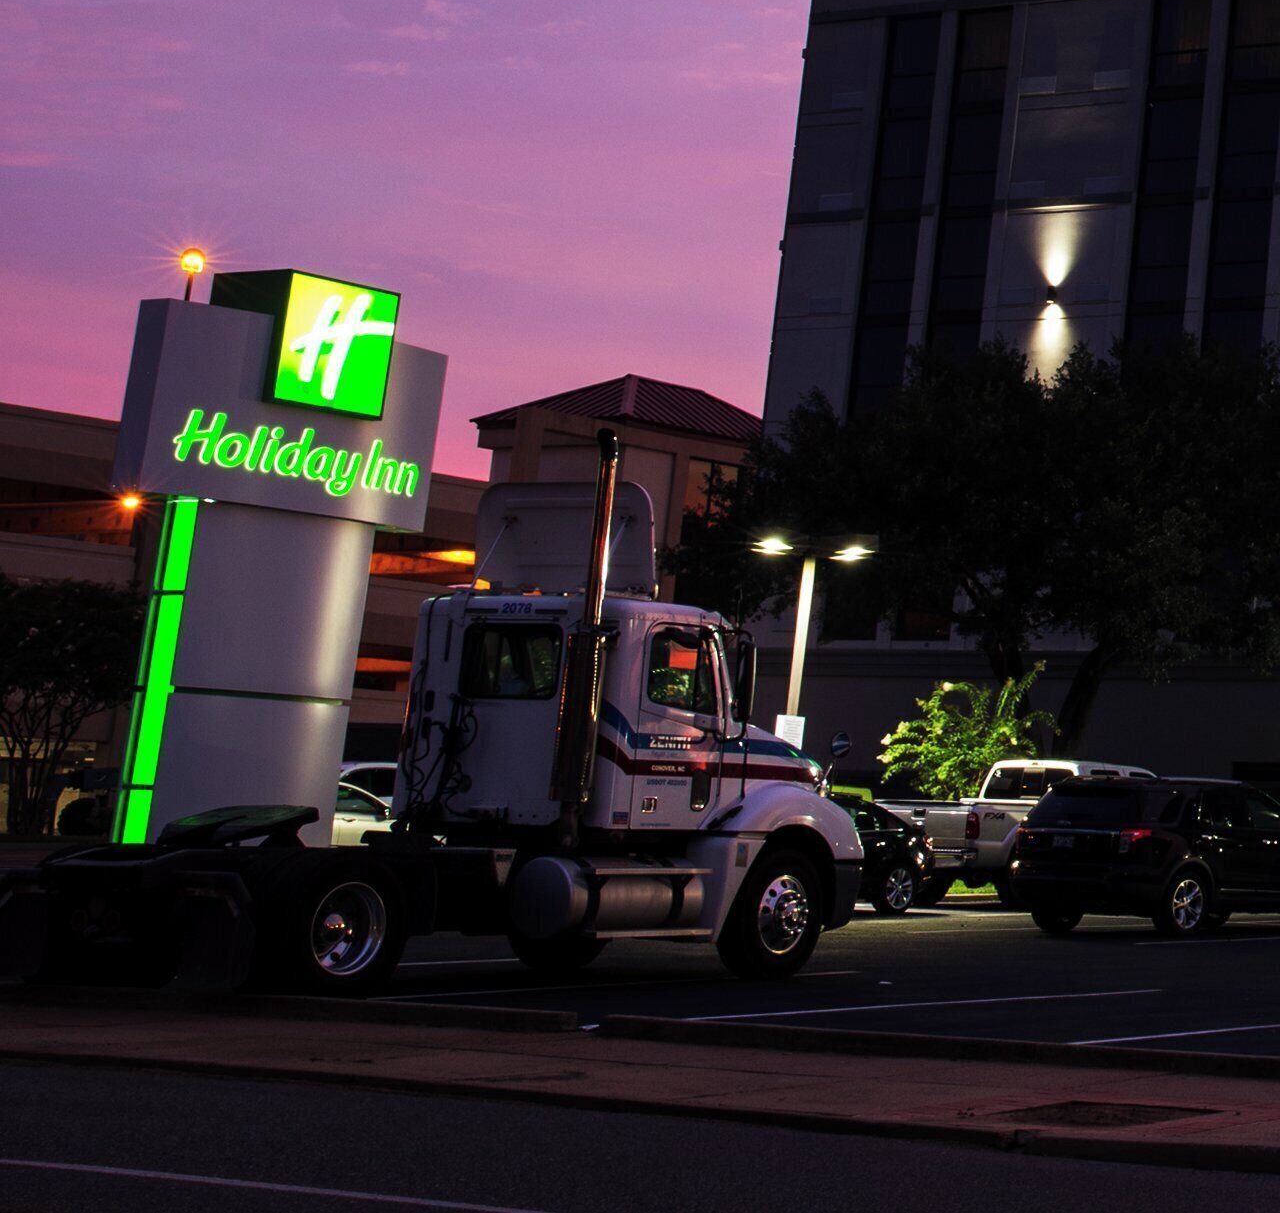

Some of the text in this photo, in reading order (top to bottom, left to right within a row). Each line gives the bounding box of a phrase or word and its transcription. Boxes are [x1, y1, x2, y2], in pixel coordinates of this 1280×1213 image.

[173, 408, 420, 498] Holiday Inn
[502, 602, 533, 614] 2078
[649, 736, 692, 749] ZENITH
[983, 812, 1005, 821] FX4
